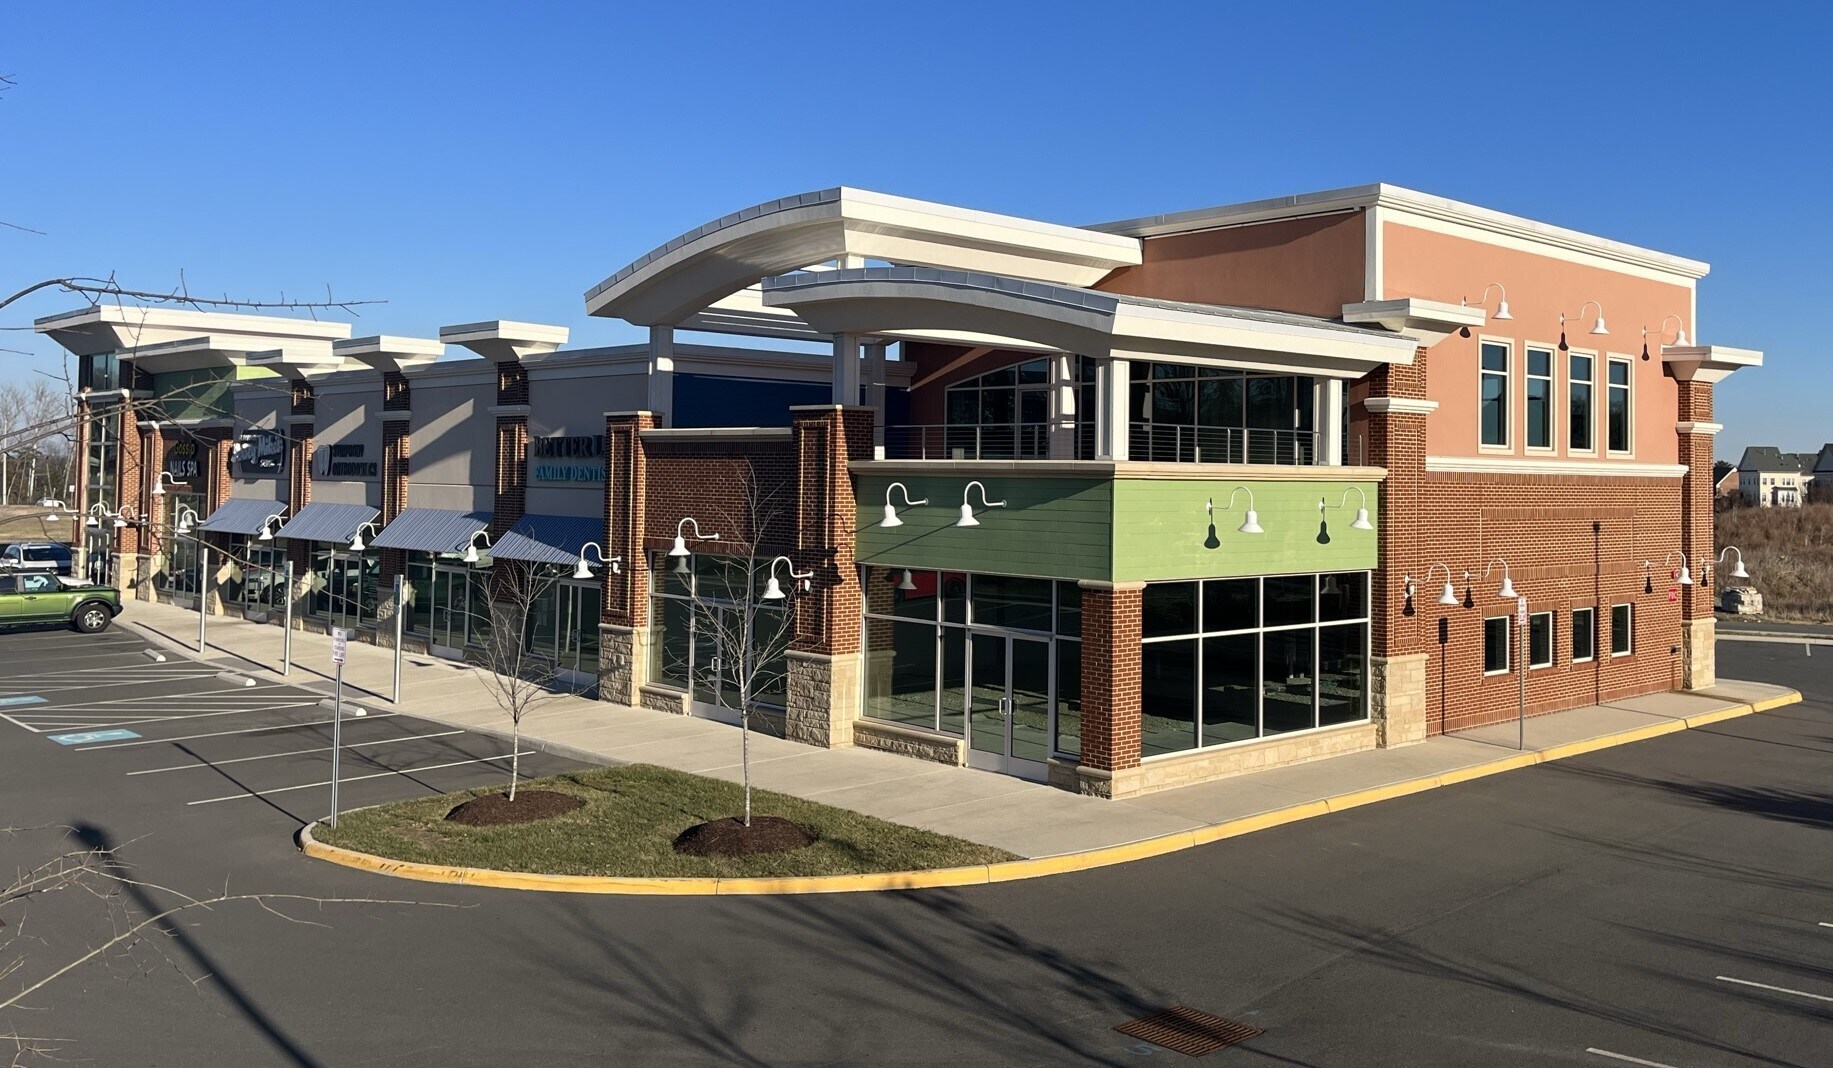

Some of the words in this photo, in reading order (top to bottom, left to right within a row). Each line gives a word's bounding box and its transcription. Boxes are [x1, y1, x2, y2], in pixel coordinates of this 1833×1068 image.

[534, 435, 593, 457] BETTER
[187, 460, 198, 477] SPA
[536, 465, 569, 480] FAMILY
[571, 465, 606, 481] DENTIS
